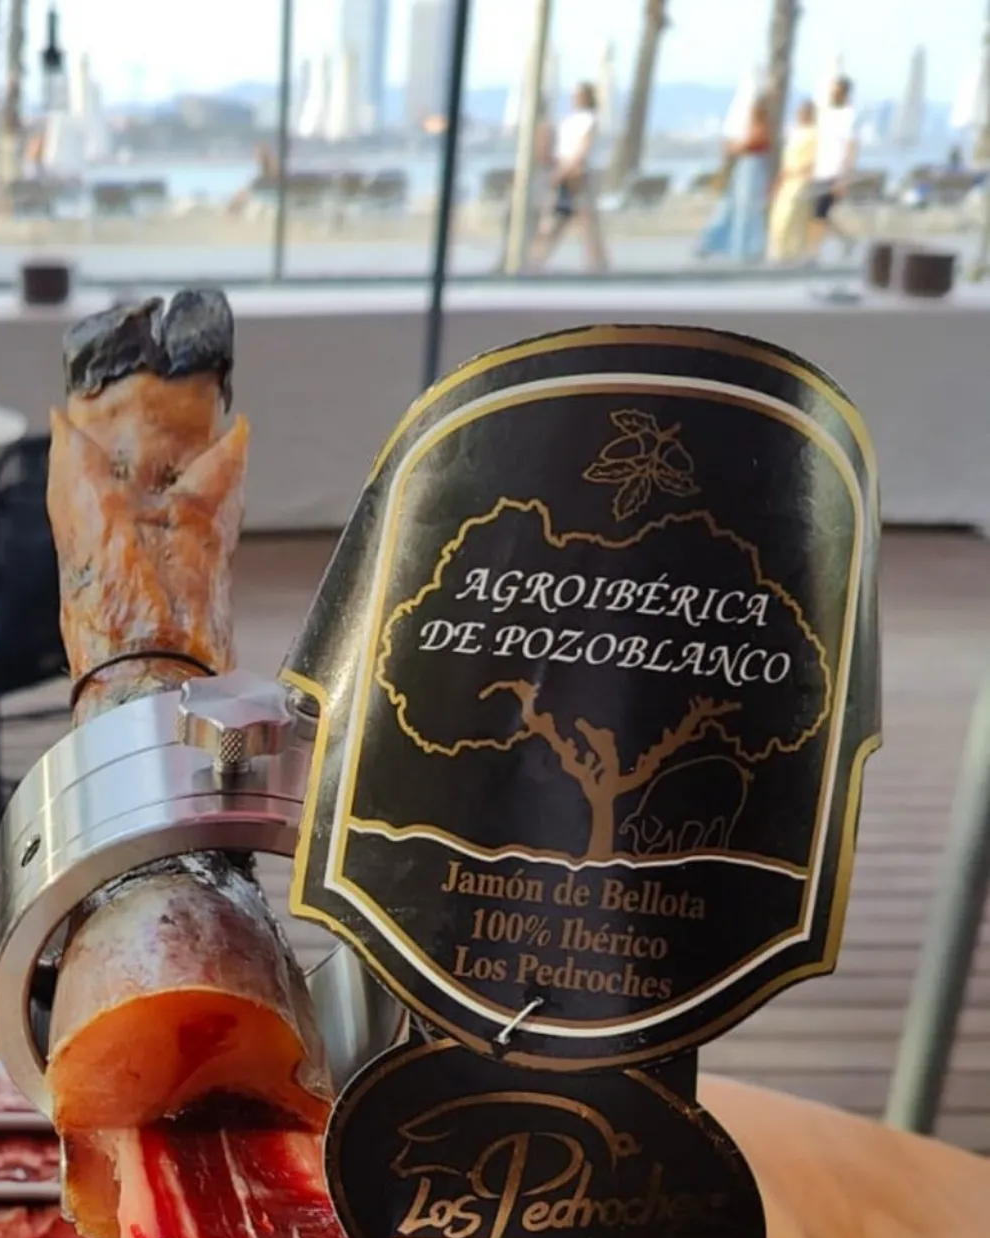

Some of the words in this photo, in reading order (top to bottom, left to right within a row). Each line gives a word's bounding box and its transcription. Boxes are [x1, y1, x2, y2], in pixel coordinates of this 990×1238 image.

[456, 568, 770, 626] AGROIBÉRICA
[419, 620, 485, 654] DE
[493, 625, 791, 686] POZOBLANCO
[441, 860, 543, 903] Jamón
[553, 874, 591, 907] de
[599, 878, 706, 920] Bellota
[471, 908, 552, 947] 100%
[561, 918, 668, 960] Ibérico
[454, 946, 508, 982] Los
[514, 953, 673, 1000] Pedroches
